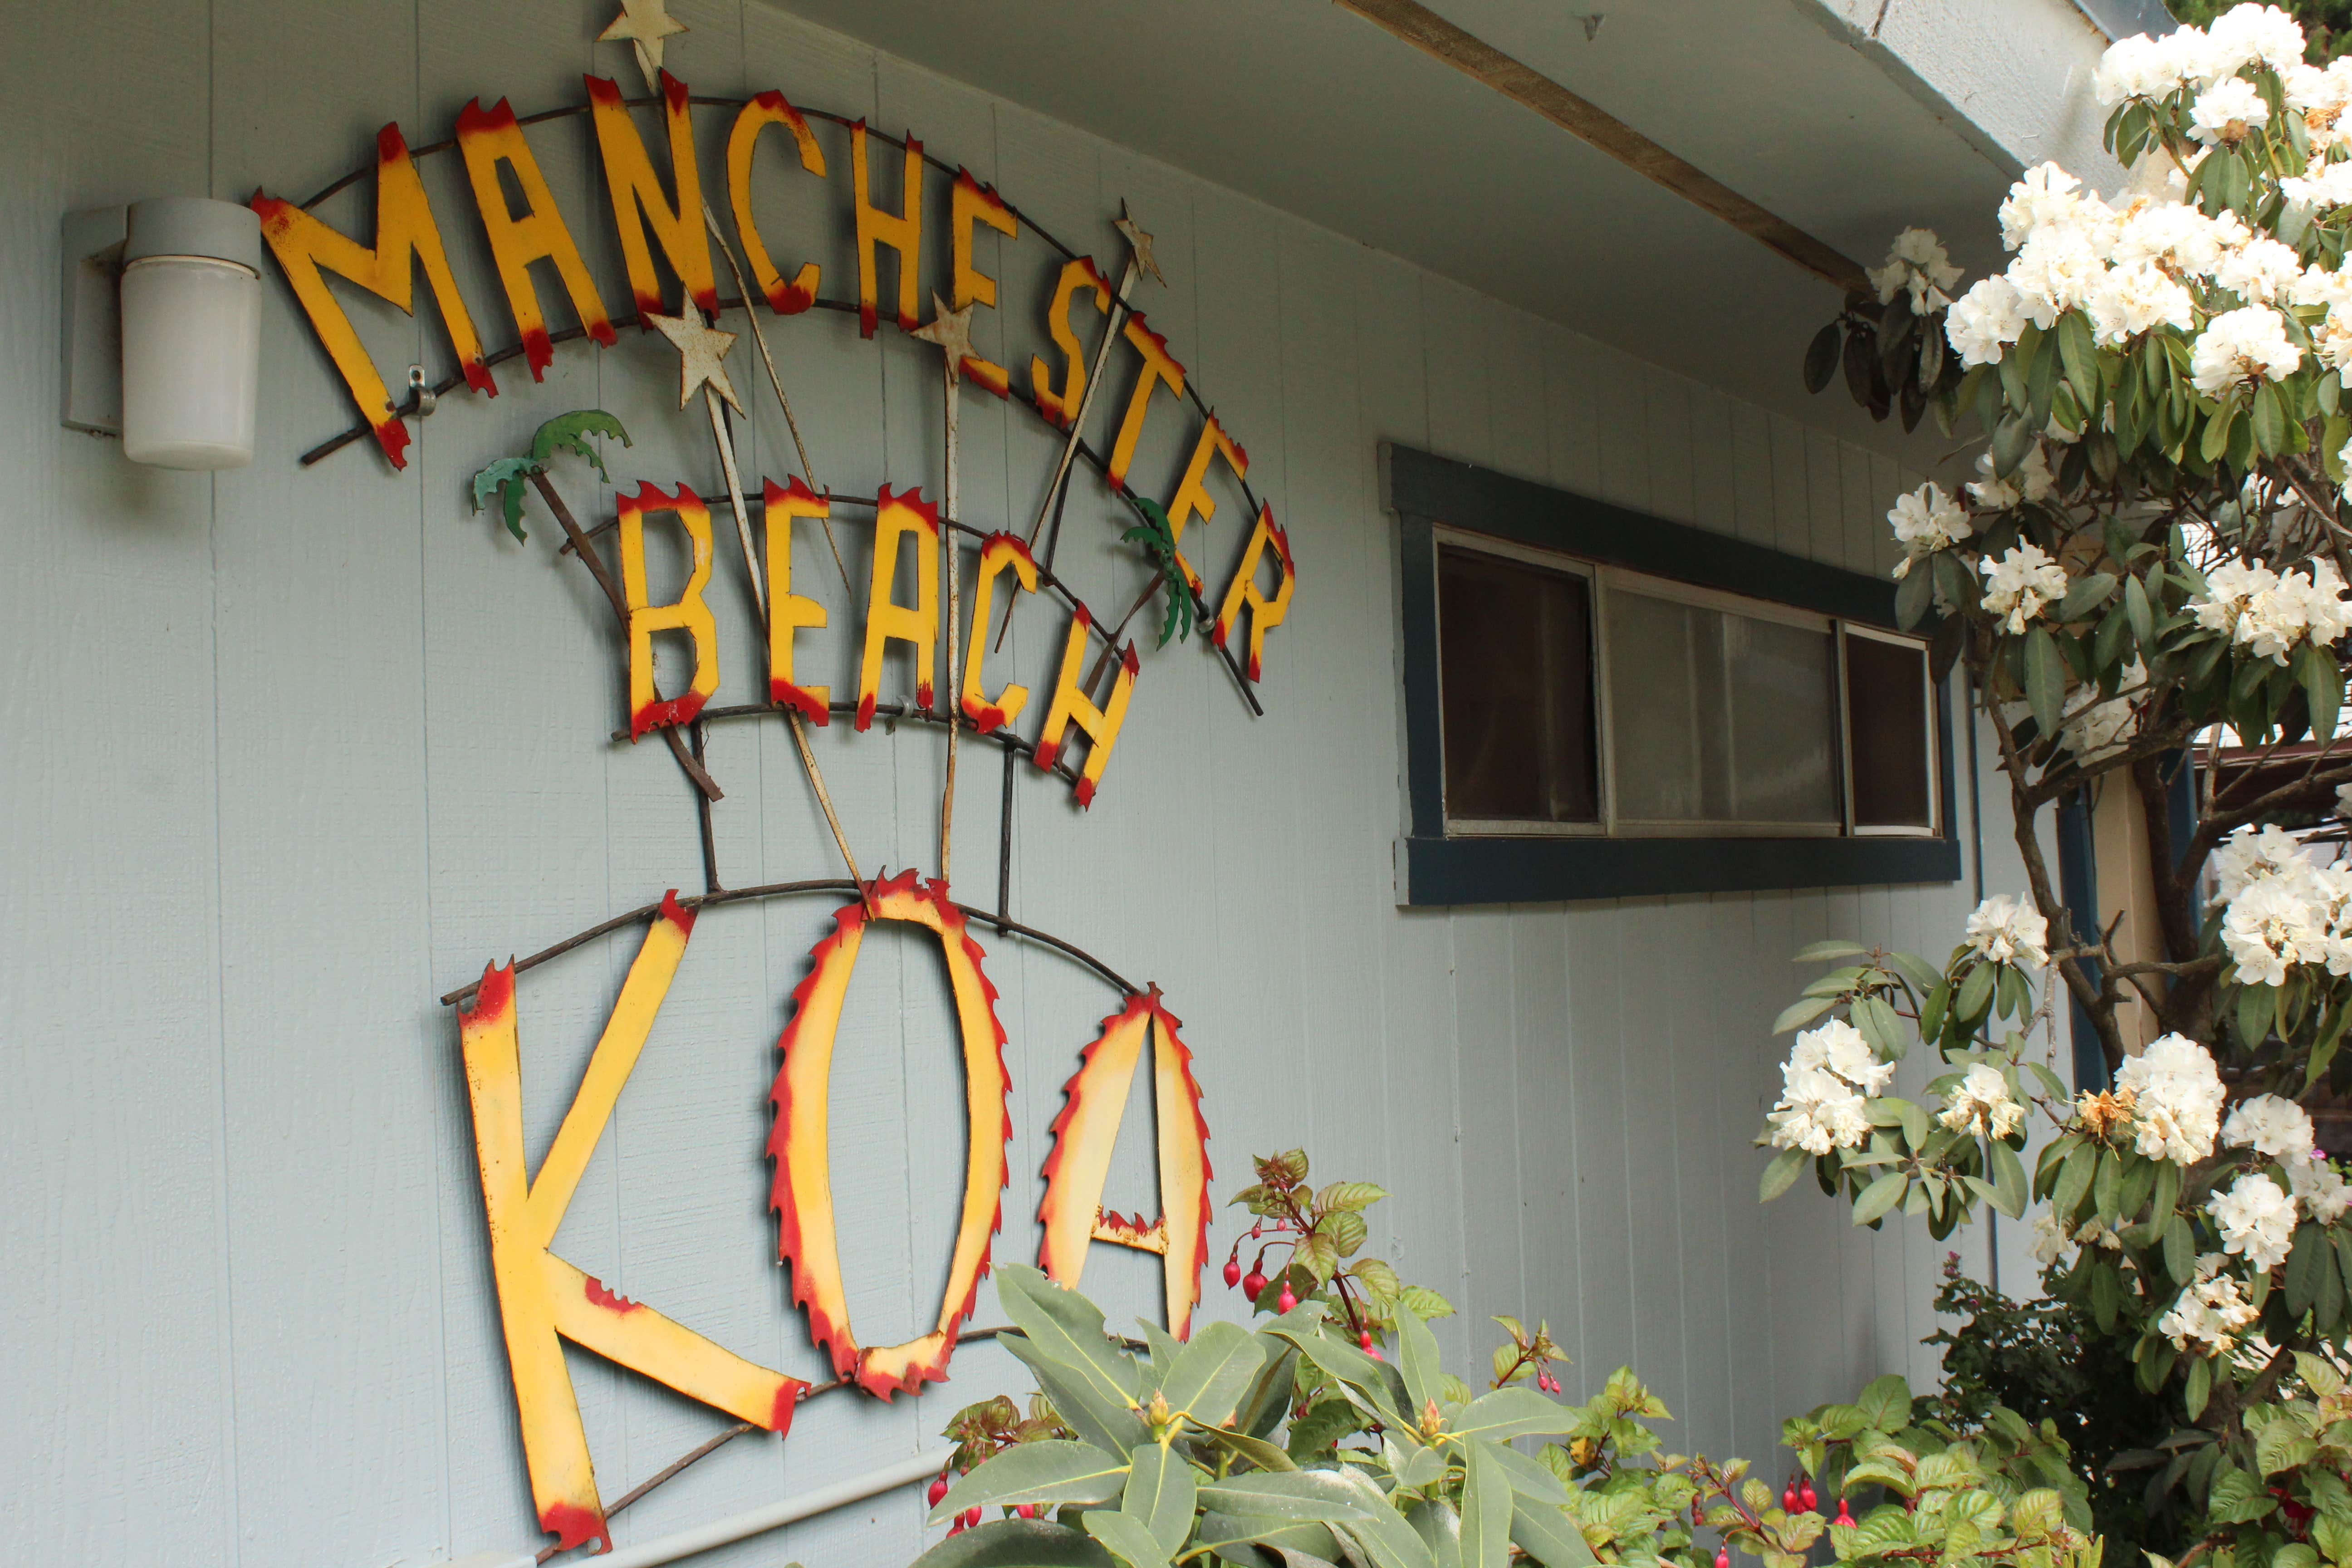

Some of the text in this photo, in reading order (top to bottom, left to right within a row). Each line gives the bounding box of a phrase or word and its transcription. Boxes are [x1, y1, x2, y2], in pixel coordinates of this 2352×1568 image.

[250, 69, 1295, 683] MANCHESTER
[616, 474, 1140, 811] BEACH
[458, 865, 1214, 1555] KOA
